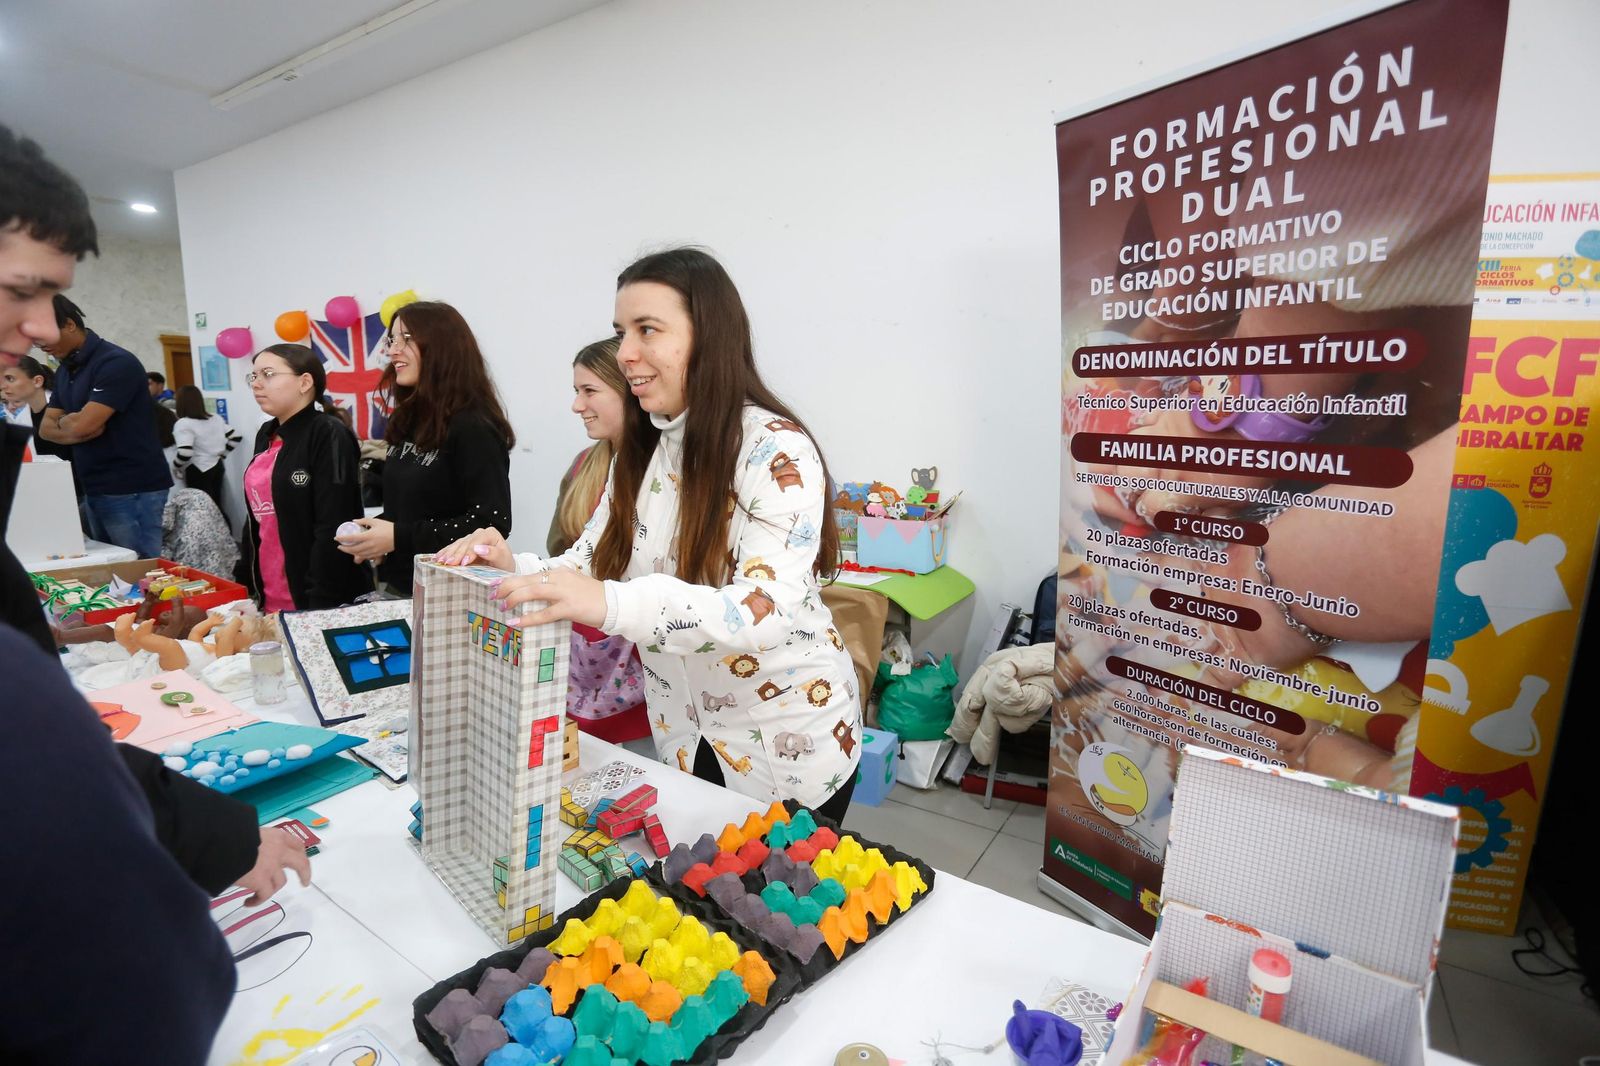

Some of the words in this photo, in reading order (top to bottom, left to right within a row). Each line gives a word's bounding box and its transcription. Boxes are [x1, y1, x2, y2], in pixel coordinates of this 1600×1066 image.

[1110, 46, 1413, 167] FORMACIÓN
[1089, 89, 1448, 206] PROFESIONAL
[1182, 170, 1304, 223] DUAL
[1120, 238, 1182, 264] CICLO
[1188, 210, 1342, 255] FORMATIVO
[1505, 231, 1543, 241] MACHADO
[1091, 276, 1114, 295] DE
[1120, 265, 1195, 292] GRADO
[1201, 245, 1338, 283] SUPERIOR
[1347, 237, 1388, 265] DE
[1480, 271, 1515, 279] CICLOS
[1102, 286, 1228, 321] EDUCACIÓN
[1235, 277, 1362, 309] INFANTIL
[1079, 342, 1238, 370] DENOMINACIÓN
[1245, 344, 1292, 366] DEL
[1300, 335, 1407, 364] TÍTULO
[1462, 336, 1600, 398] FCF
[1078, 394, 1126, 409] Técnico
[1130, 394, 1195, 412] Superior
[1199, 397, 1218, 411] en
[1223, 393, 1319, 413] Educación
[1323, 394, 1406, 415] Infantil
[1460, 404, 1548, 426] AMPO
[1553, 406, 1590, 427] DE
[1101, 440, 1176, 462] FAMILIA
[1181, 445, 1351, 476] PROFESIONAL
[1456, 430, 1584, 452] IBRALTAR
[1076, 472, 1129, 487] SERVICIOS
[1131, 478, 1245, 500] SOCIOCULTURALES
[1272, 491, 1291, 506] LA
[1293, 494, 1394, 517] COMUNIDAD
[1086, 528, 1102, 542] 20
[1105, 531, 1150, 550] plazas
[1153, 539, 1228, 565] ofertadas
[1191, 521, 1244, 539] CURSO
[1086, 550, 1160, 576] Formación
[1163, 567, 1237, 591] empresa:
[1242, 579, 1359, 617] Enero-Junio
[1068, 594, 1082, 608] 20
[1085, 600, 1126, 619] plazas
[1129, 611, 1202, 640] ofertadas.
[1186, 600, 1238, 623] CURSO
[1068, 614, 1130, 641] Formación
[1134, 633, 1149, 646] en
[1152, 639, 1225, 668] empresas:
[1229, 658, 1380, 713] Noviembre-junio
[1126, 666, 1195, 698] DURACIÓN
[1199, 689, 1226, 709] DEL
[1229, 700, 1276, 725] CICLO
[1112, 715, 1171, 745] alternancia
[1113, 700, 1132, 714] 660
[1134, 705, 1163, 724] horas
[1164, 718, 1184, 734] son
[1187, 723, 1201, 739] de
[1204, 731, 1268, 764] formación
[1126, 688, 1154, 706] 2.000
[1157, 698, 1190, 720] horas,
[1193, 709, 1208, 725] de
[1210, 714, 1228, 732] las
[1230, 724, 1277, 750] cuales:
[1072, 814, 1116, 841] ANTONIO
